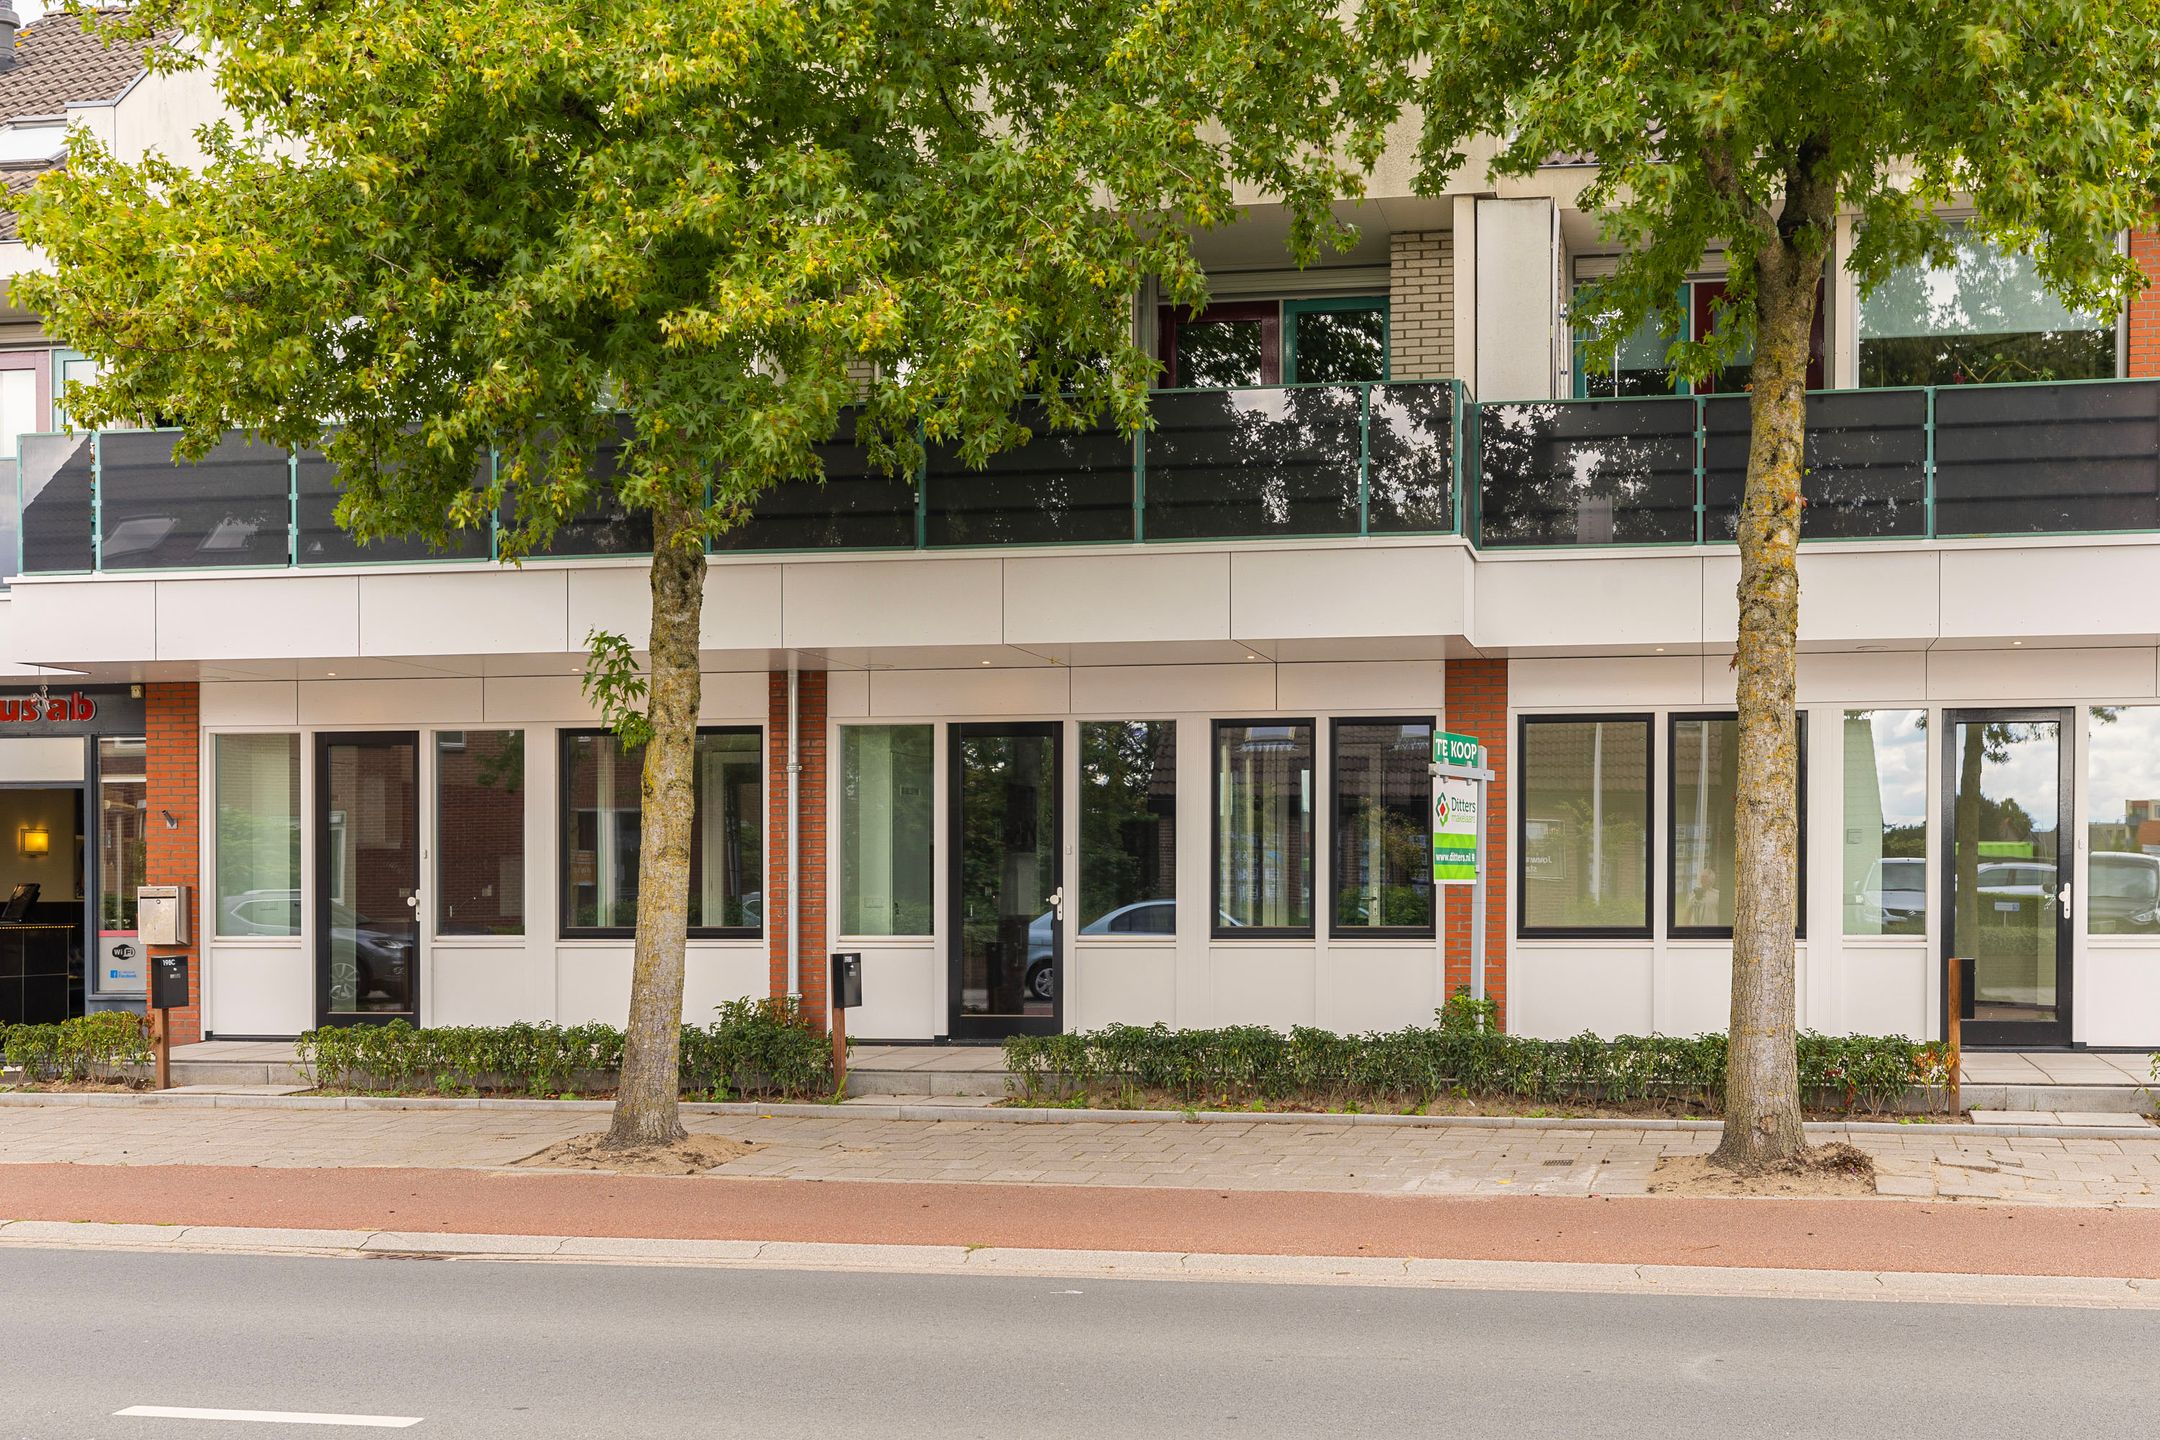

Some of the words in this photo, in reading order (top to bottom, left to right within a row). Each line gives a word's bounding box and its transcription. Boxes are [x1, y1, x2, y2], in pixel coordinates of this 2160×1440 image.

[1435, 738, 1448, 757] TE
[1450, 740, 1477, 760] KOOP
[1451, 796, 1476, 813] Ditters
